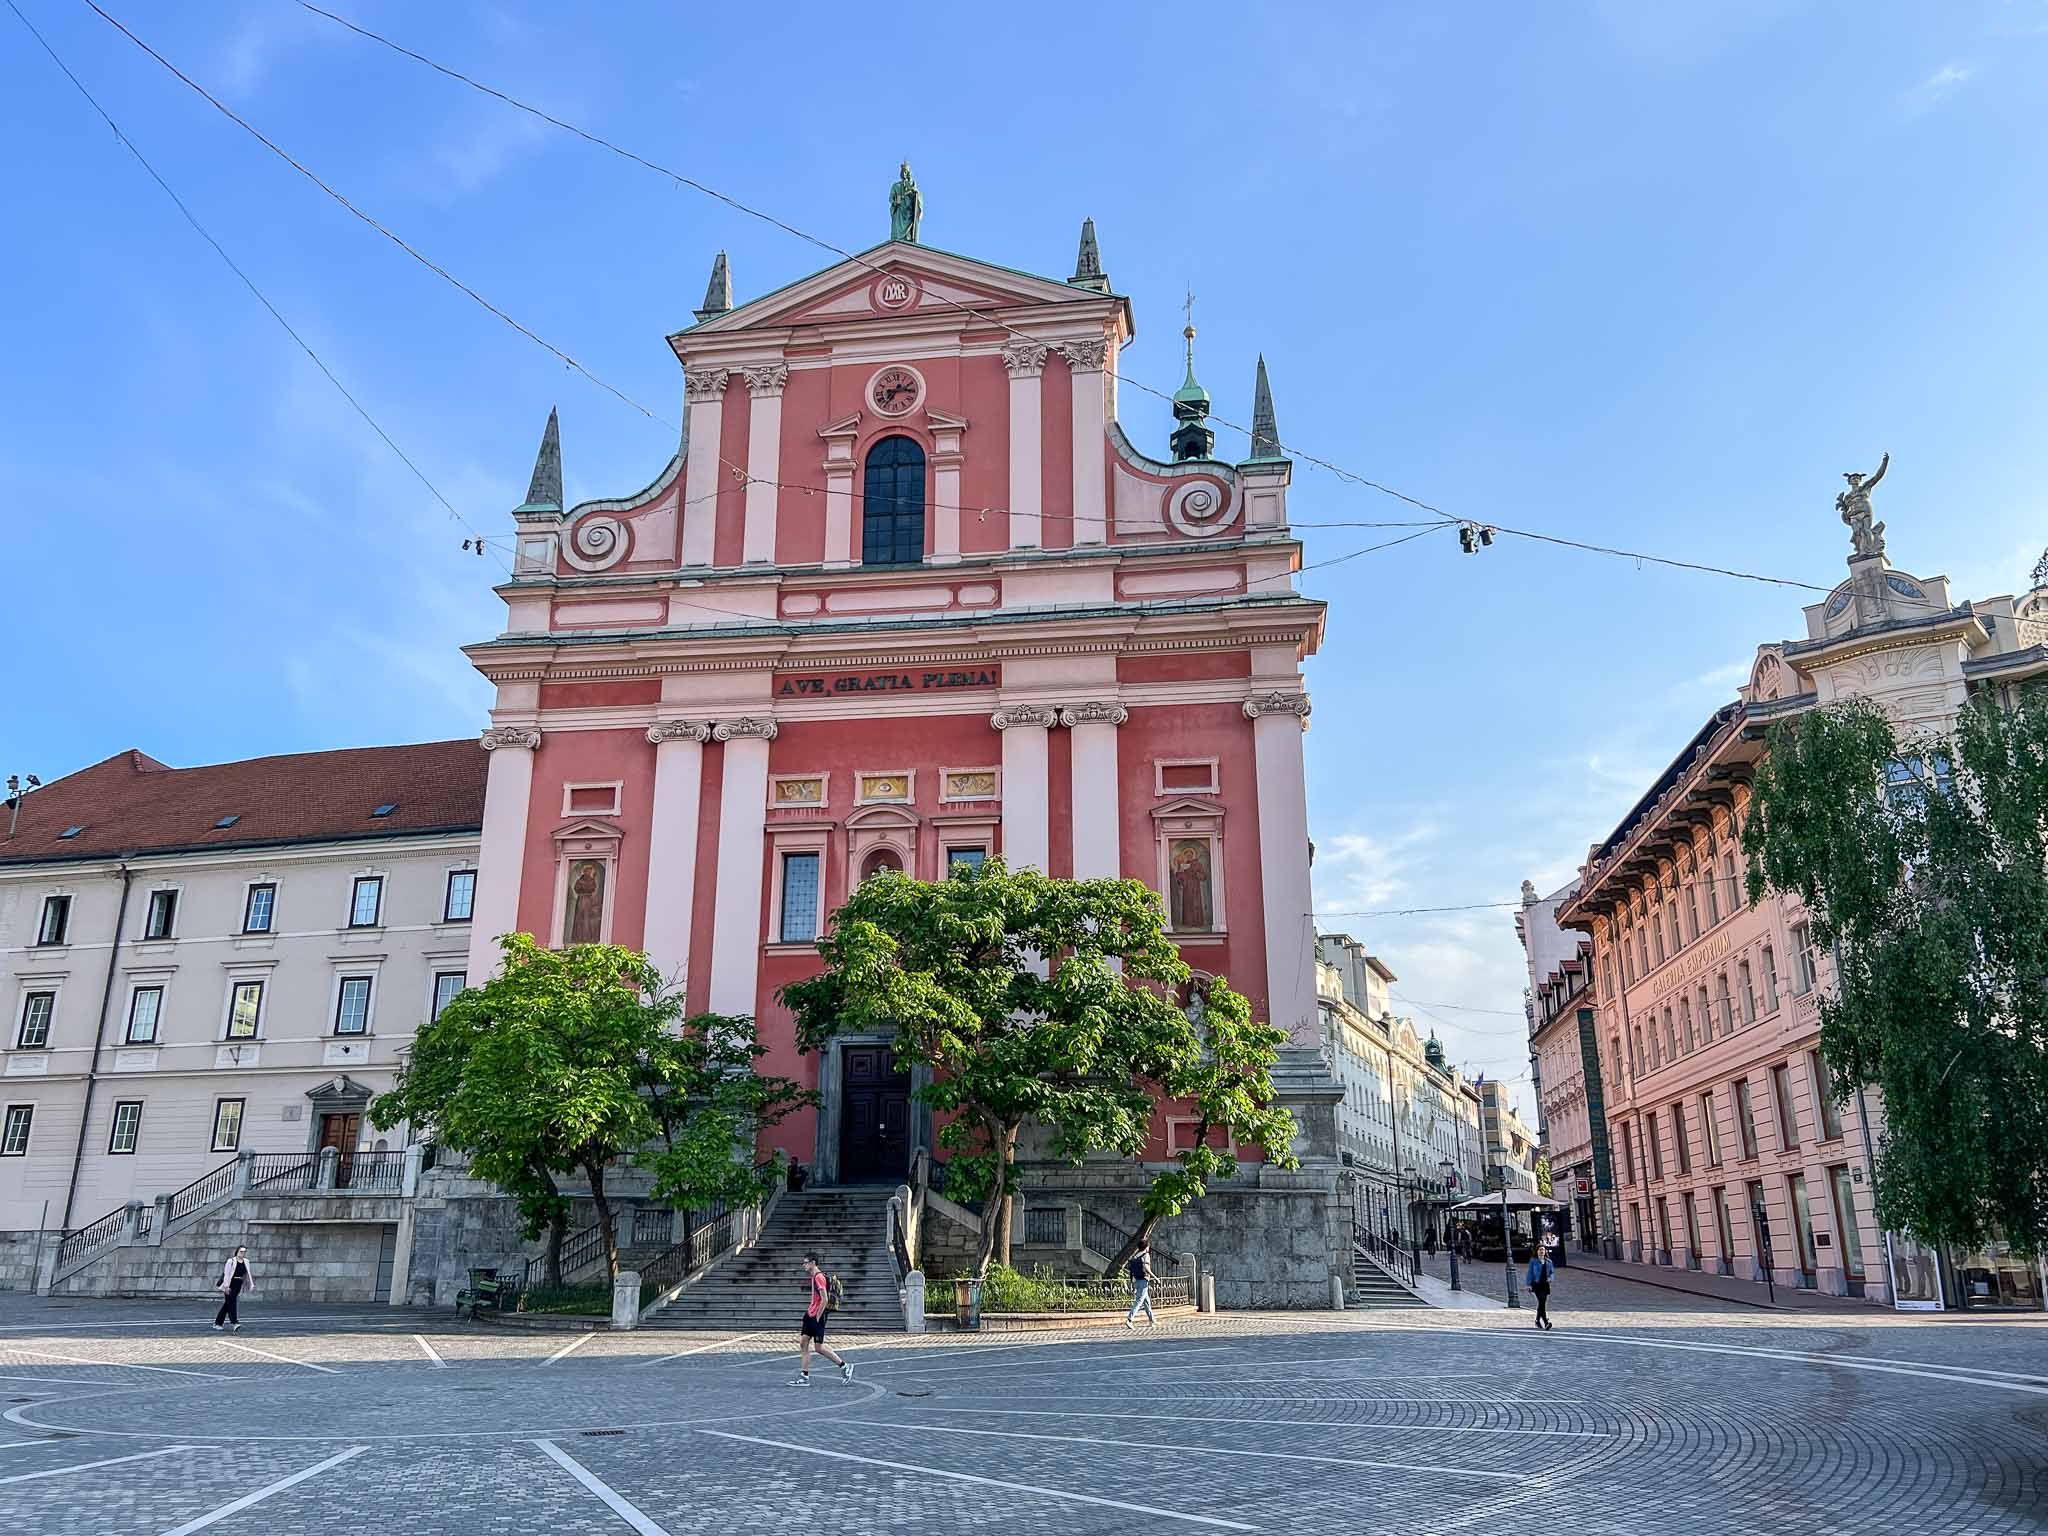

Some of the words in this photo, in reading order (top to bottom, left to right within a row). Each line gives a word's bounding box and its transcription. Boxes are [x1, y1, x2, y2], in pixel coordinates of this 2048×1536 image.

[834, 675, 913, 692] GRATIA
[921, 671, 997, 688] PLENA!
[1687, 931, 1731, 976] EMPORIUM
